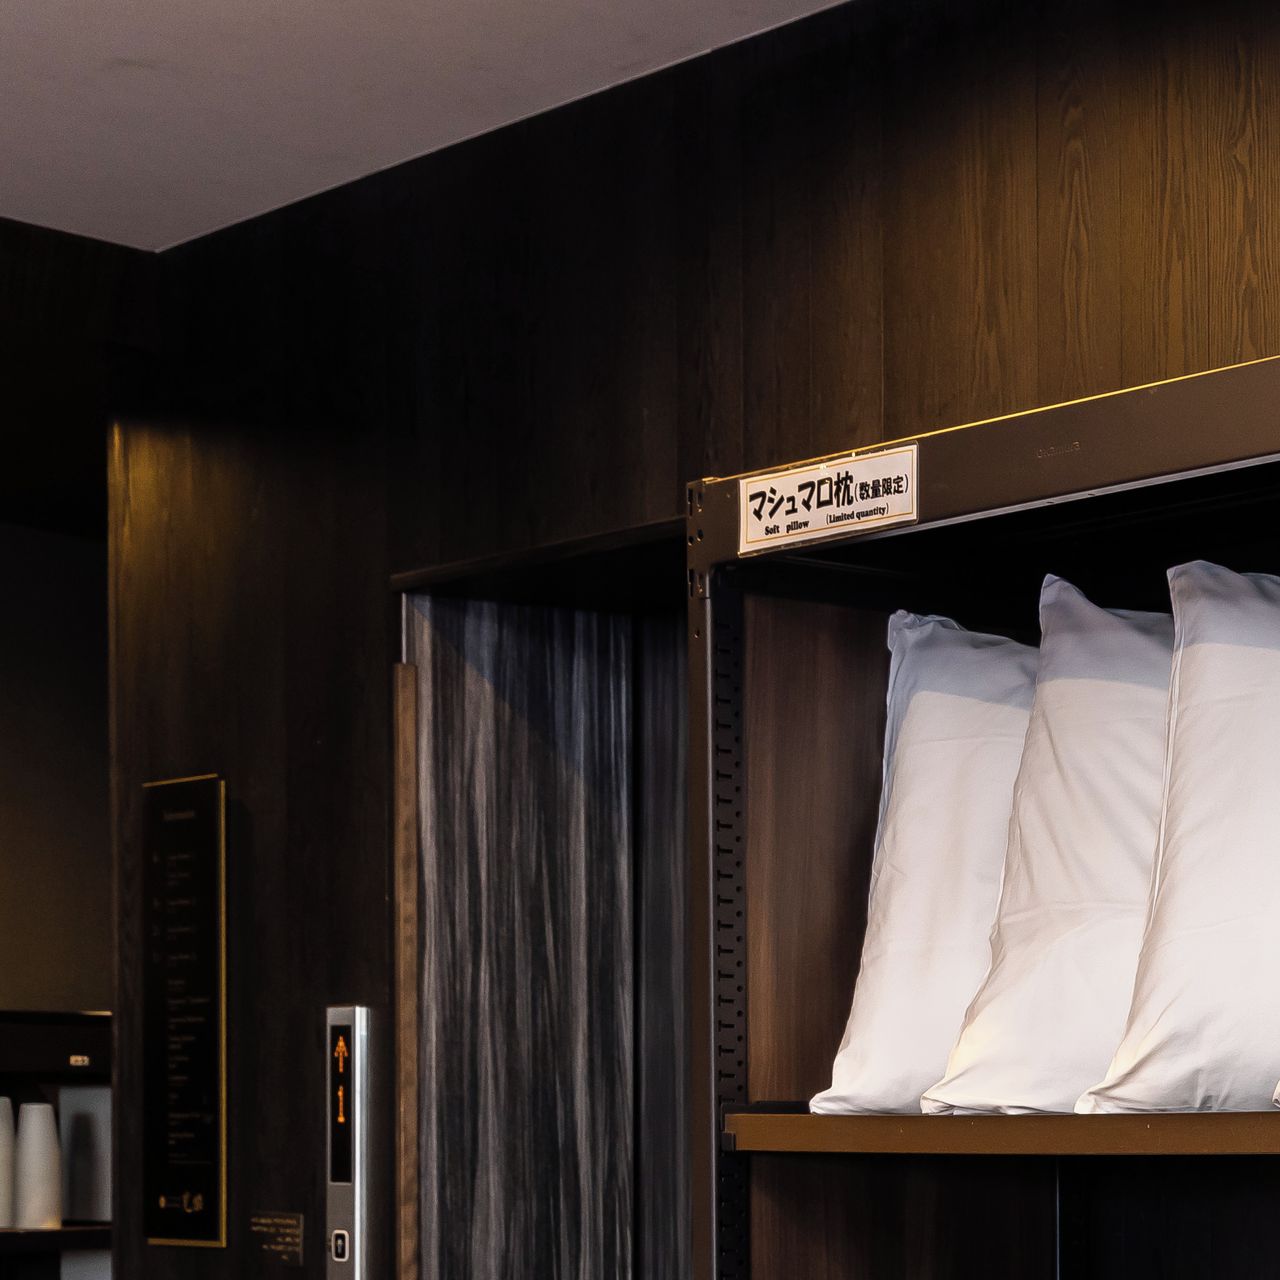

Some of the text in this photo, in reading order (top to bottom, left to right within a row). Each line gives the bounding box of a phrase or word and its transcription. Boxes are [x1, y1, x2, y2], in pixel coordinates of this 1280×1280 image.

[749, 471, 909, 521] マシュマロ枕(数量限定)
[764, 503, 889, 535] Soft pillow (Limited quantity)
